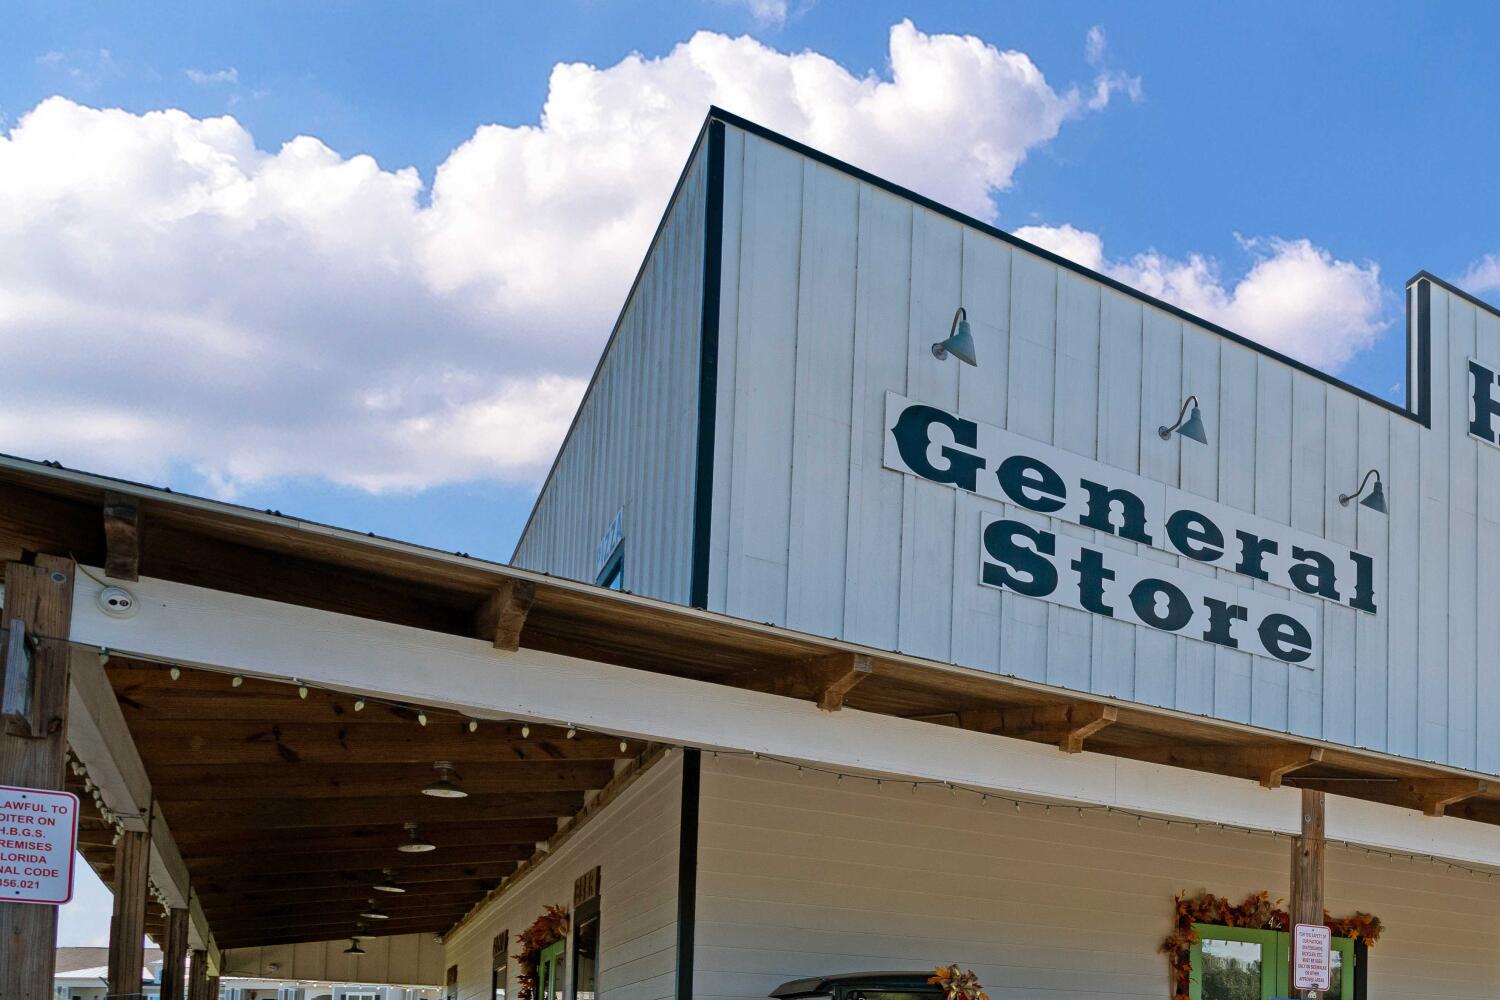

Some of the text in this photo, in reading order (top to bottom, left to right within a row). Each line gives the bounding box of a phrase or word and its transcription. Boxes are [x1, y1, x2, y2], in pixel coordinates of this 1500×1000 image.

[890, 404, 1377, 615] General
[982, 519, 1313, 663] Store
[52, 805, 68, 814] TO
[38, 817, 55, 826] ON
[24, 867, 59, 877] CODE
